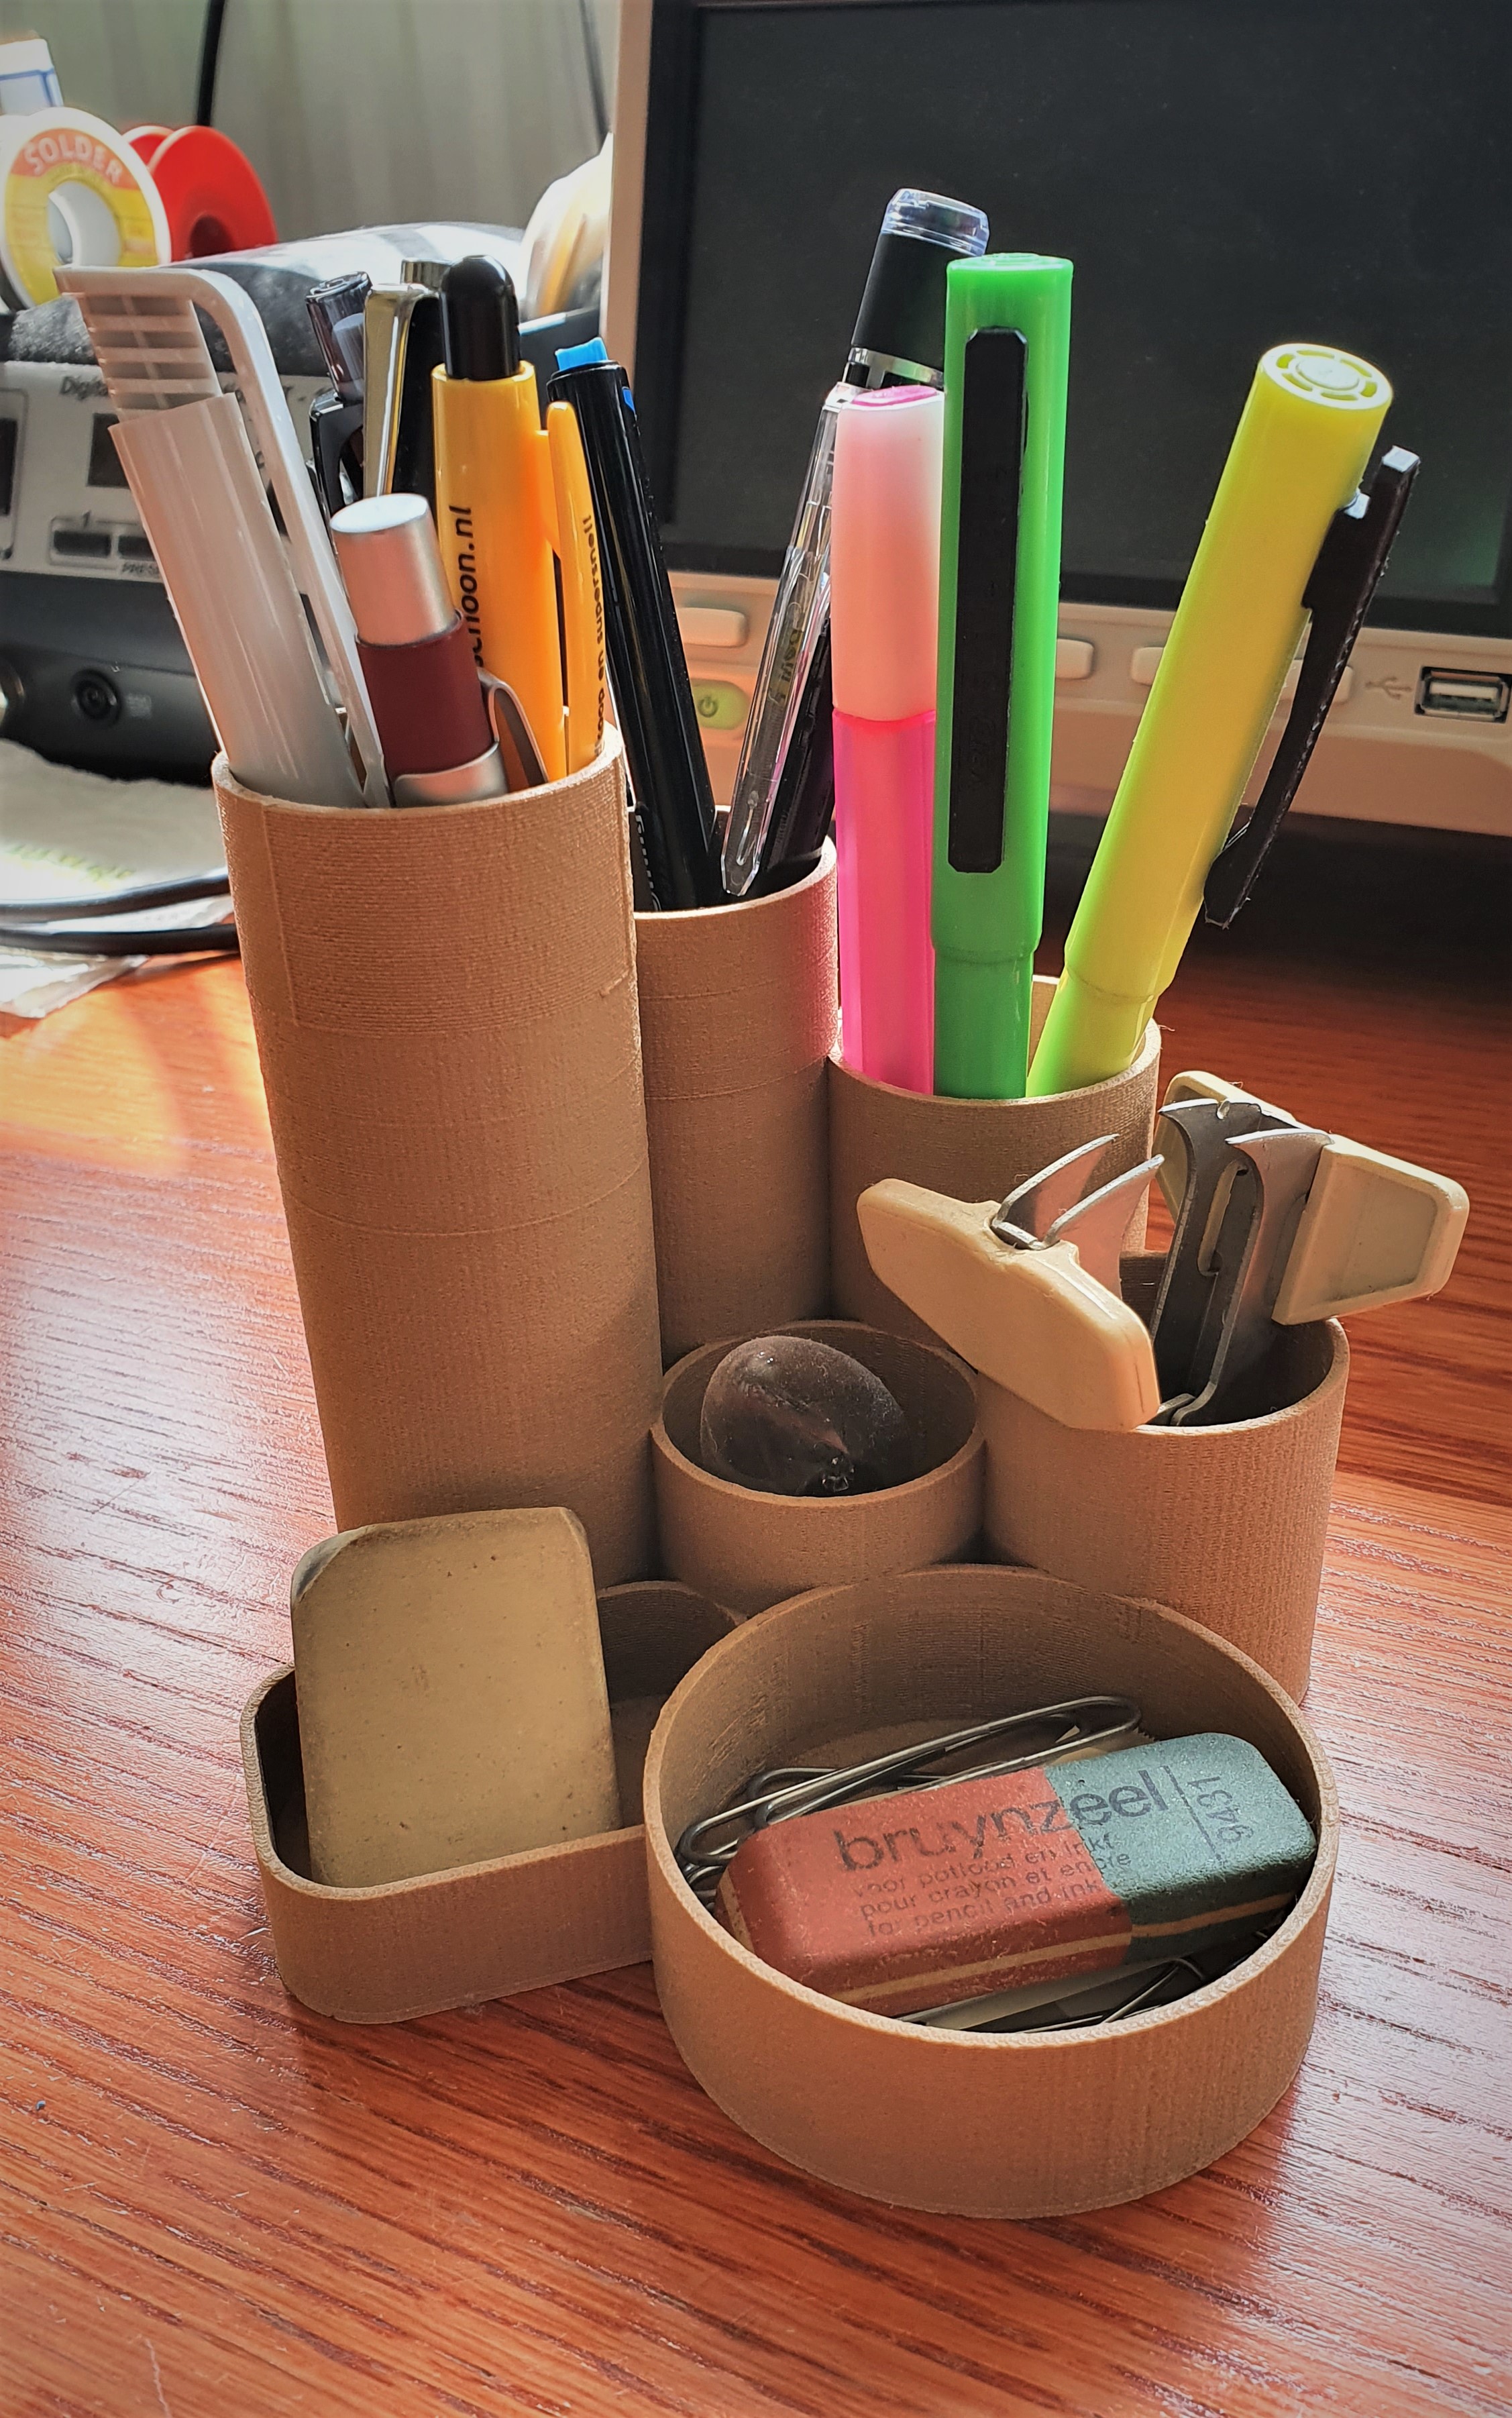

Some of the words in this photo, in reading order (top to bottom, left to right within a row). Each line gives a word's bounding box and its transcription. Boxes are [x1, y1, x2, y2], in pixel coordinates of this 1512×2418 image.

[23, 134, 123, 184] SOLDER
[833, 1769, 1169, 1872] bruynzeel
[1187, 1776, 1254, 1844] 9431
[861, 1895, 916, 1921] pour
[928, 1875, 1017, 1903] crayon
[1026, 1868, 1052, 1885] et
[918, 1852, 1016, 1888] potlood
[914, 1899, 994, 1932] pencil
[1004, 1886, 1052, 1914] and
[1061, 1879, 1101, 1901] ink
